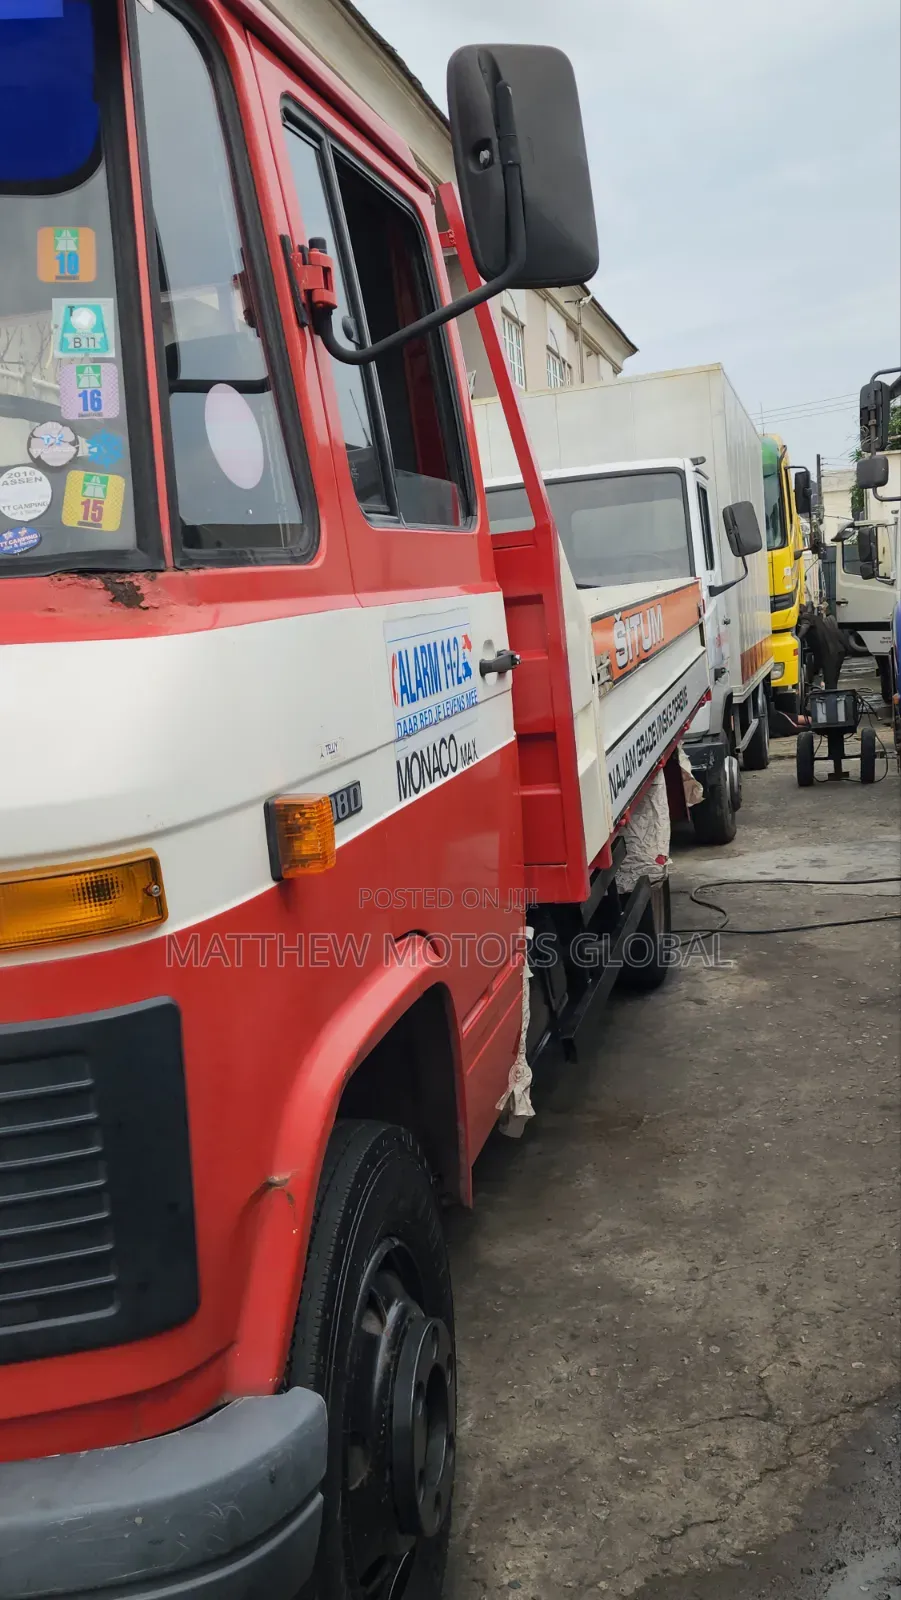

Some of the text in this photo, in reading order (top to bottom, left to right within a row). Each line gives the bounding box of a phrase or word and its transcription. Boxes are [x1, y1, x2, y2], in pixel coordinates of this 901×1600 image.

[55, 251, 79, 275] 10
[73, 337, 82, 348] B
[78, 389, 103, 413] 16
[1, 476, 43, 487] ASSEN
[13, 501, 48, 511] CAMPING
[81, 498, 104, 522] 15
[613, 603, 664, 670] ŠITUM
[397, 641, 443, 707] ALARM
[396, 689, 479, 739] DAAR RED JE LEVENS MEE
[396, 734, 479, 802] MONACO MAX
[608, 744, 637, 805] NAJAM
